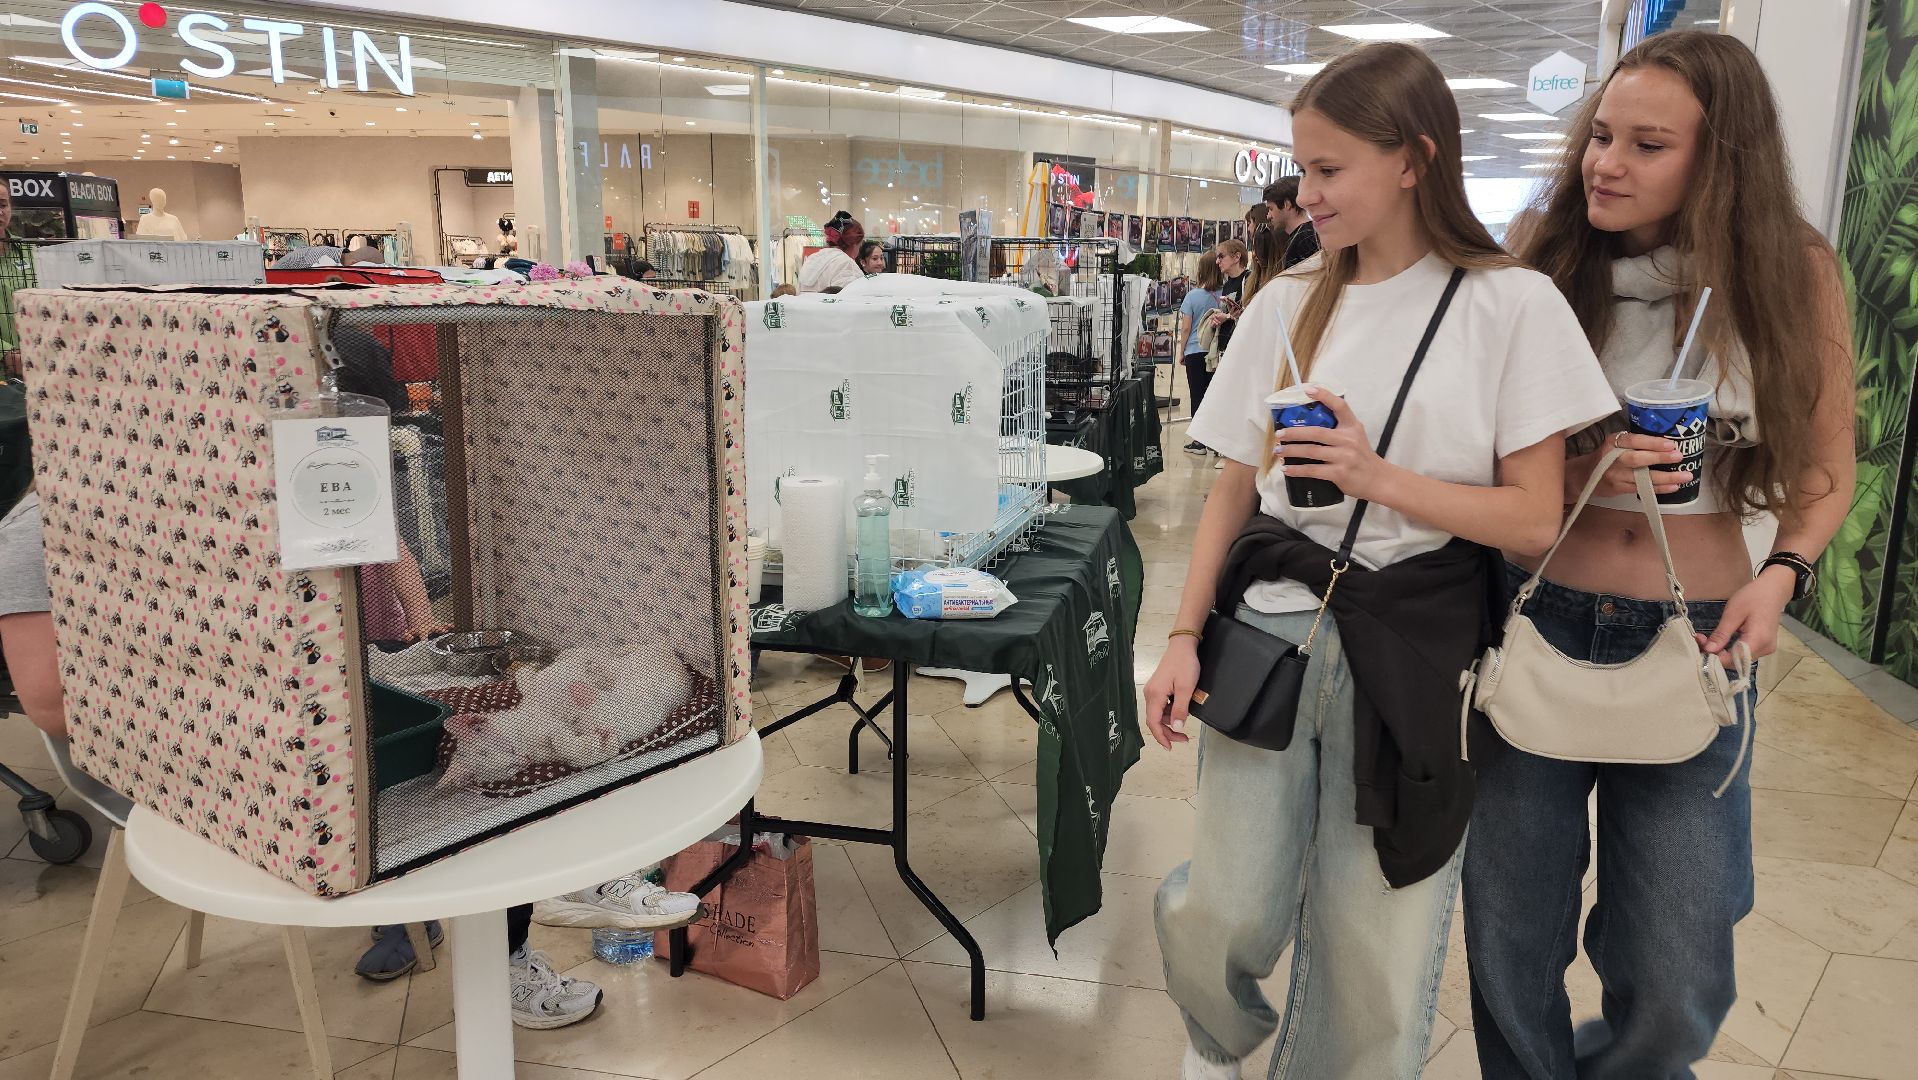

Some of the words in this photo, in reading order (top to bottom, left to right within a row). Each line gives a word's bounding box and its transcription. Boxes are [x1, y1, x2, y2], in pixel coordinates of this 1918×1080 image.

[60, 1, 416, 96] O'STIN
[1532, 74, 1579, 92] befree
[486, 171, 513, 183] ДЕТИ
[8, 178, 55, 198] BOX
[69, 181, 97, 201] BLACK
[97, 184, 114, 202] BOX
[323, 507, 330, 516] 2
[702, 902, 756, 934] SHADE
